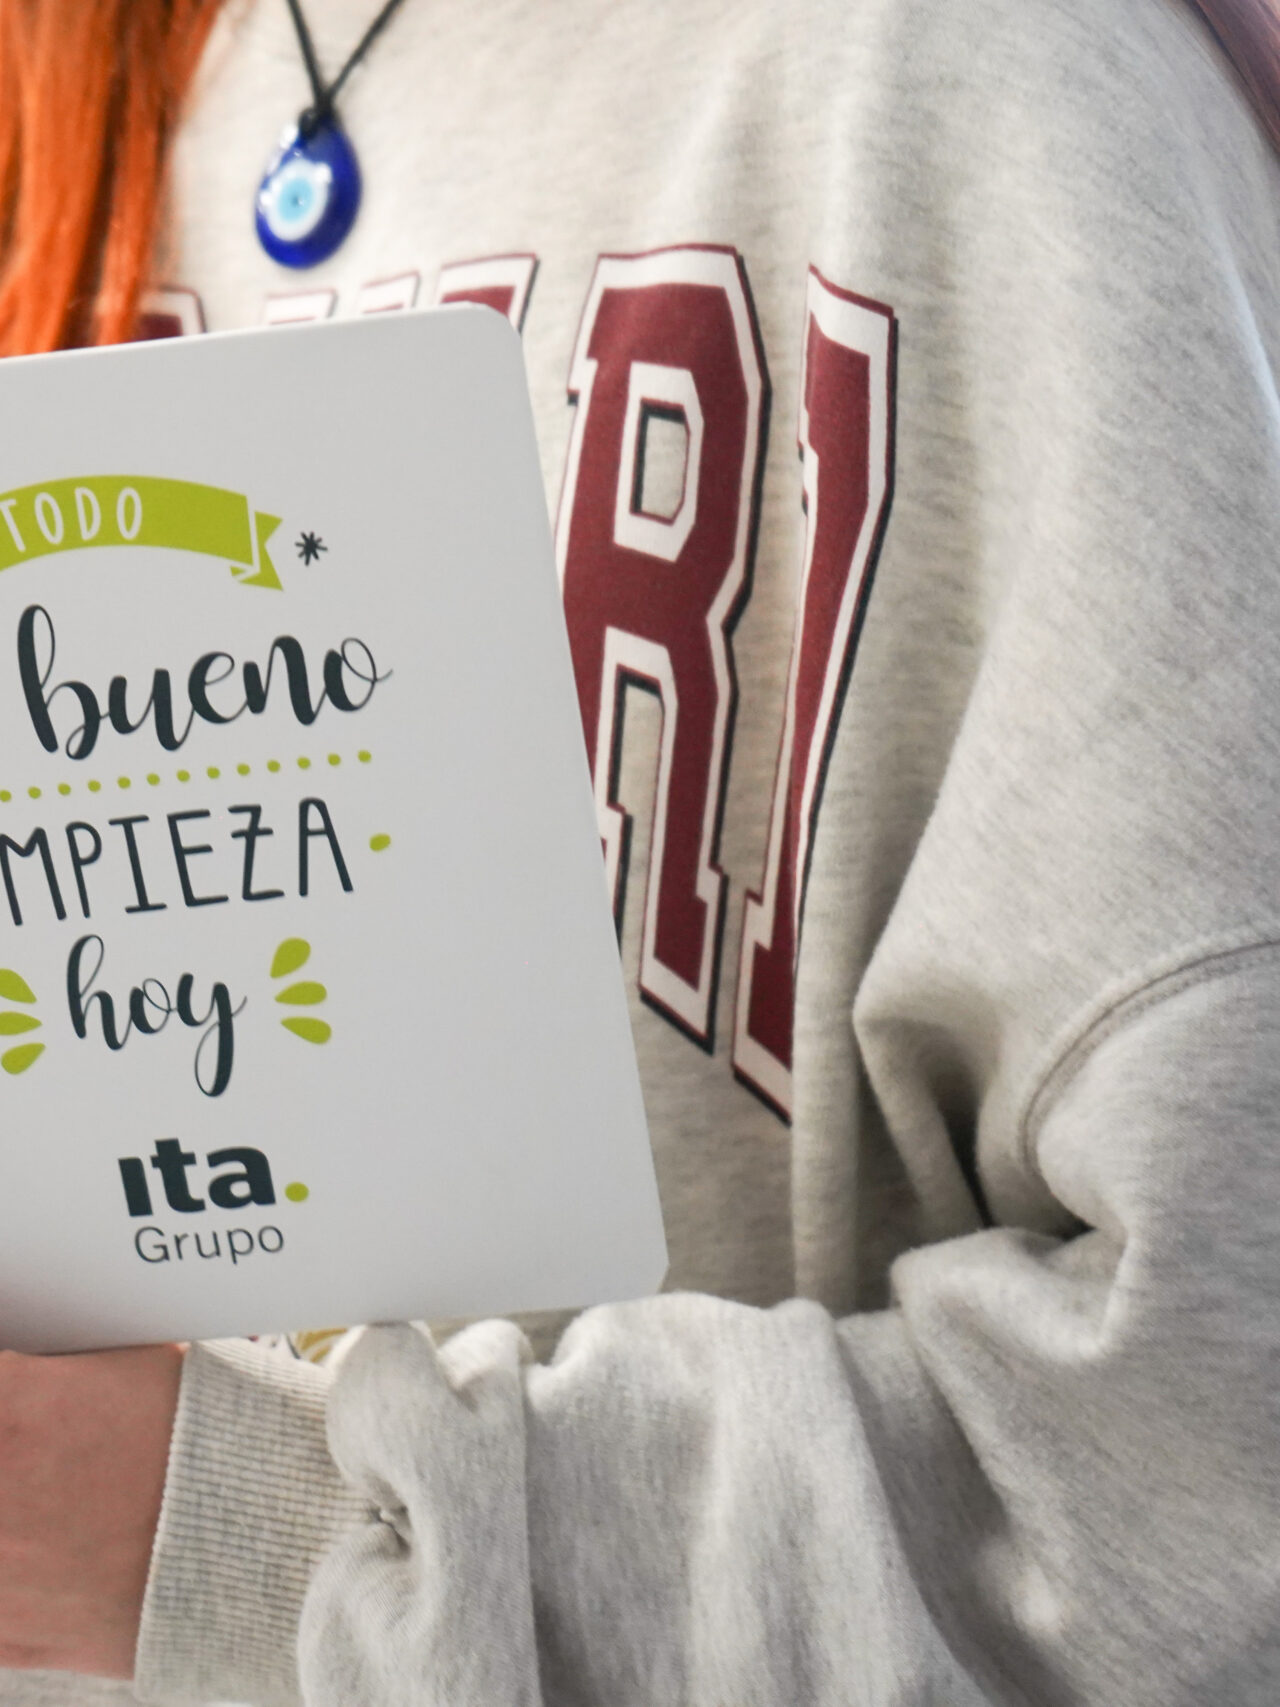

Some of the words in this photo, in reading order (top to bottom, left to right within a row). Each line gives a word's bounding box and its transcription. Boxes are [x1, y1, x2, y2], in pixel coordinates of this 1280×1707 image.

[16, 604, 393, 761] bueno
[66, 934, 248, 1098] hoy
[133, 1225, 286, 1266] Grupo
